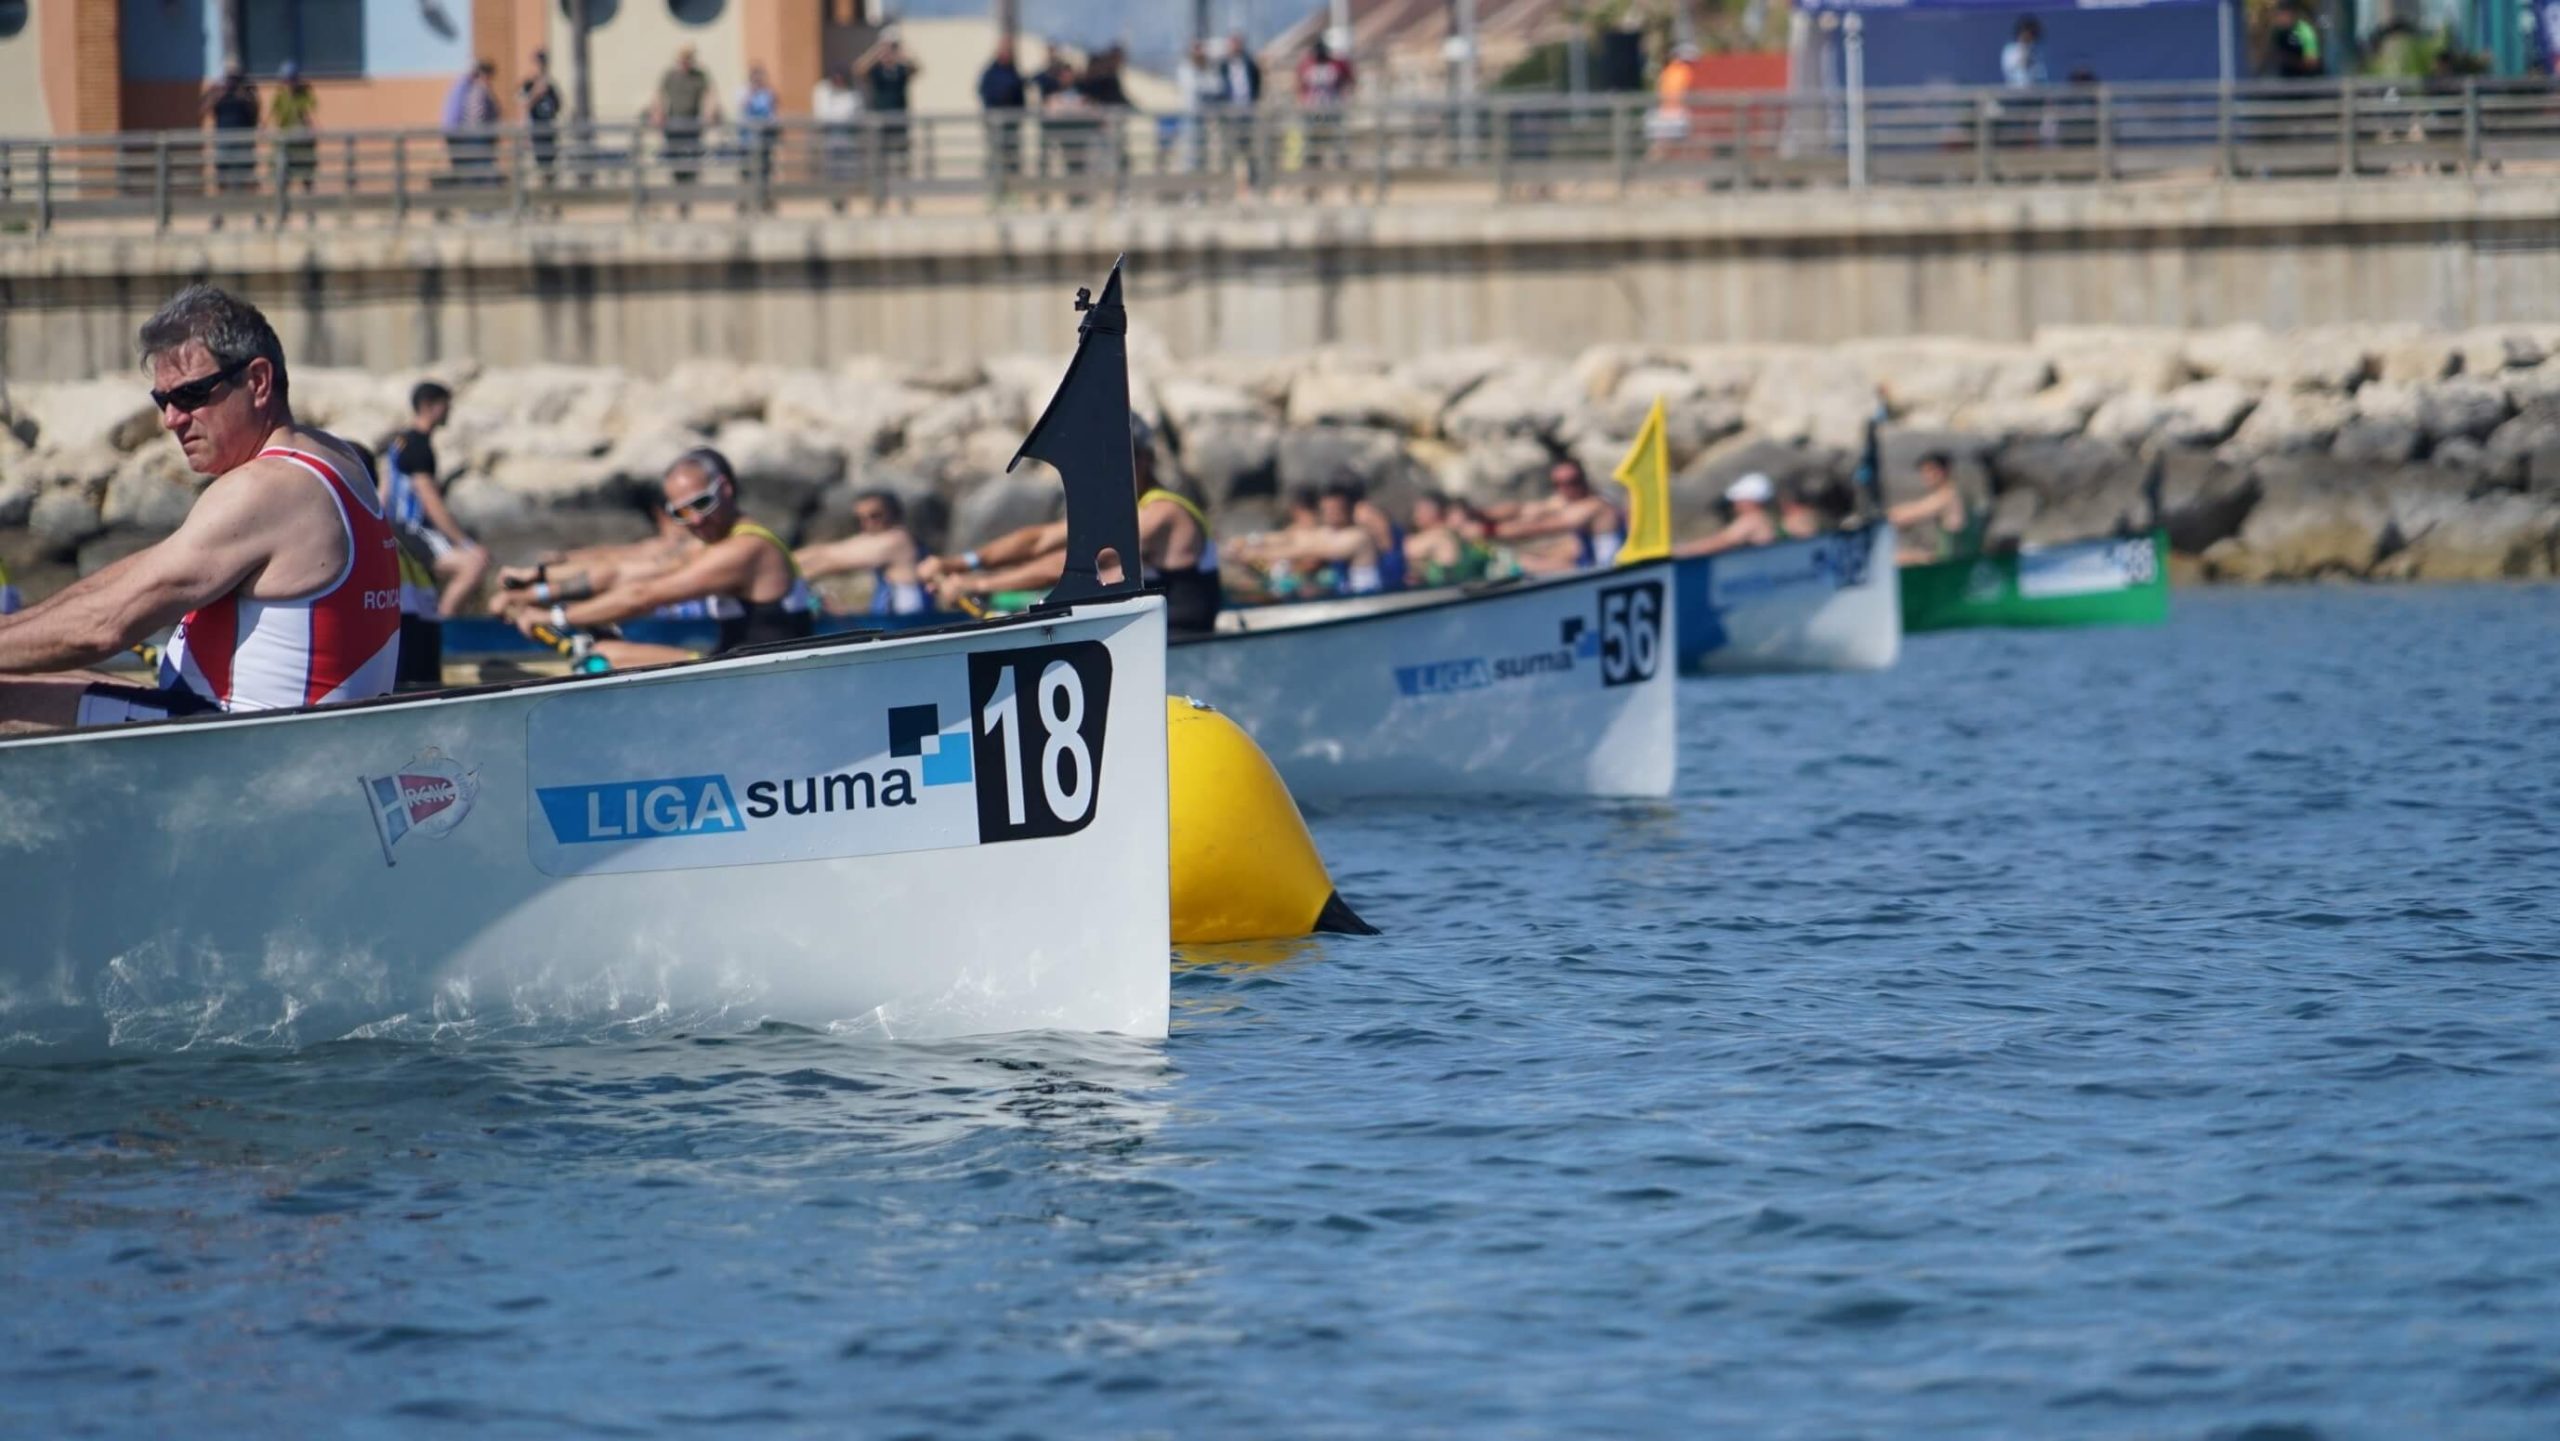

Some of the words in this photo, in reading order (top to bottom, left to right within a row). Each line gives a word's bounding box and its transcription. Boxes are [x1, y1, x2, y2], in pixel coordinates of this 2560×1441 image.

[1417, 658, 1490, 690] LIGA
[1494, 650, 1573, 681] suma
[1603, 590, 1657, 681] 56
[983, 659, 1093, 826] 18
[587, 783, 735, 837] LIGA
[746, 768, 917, 818] suma
